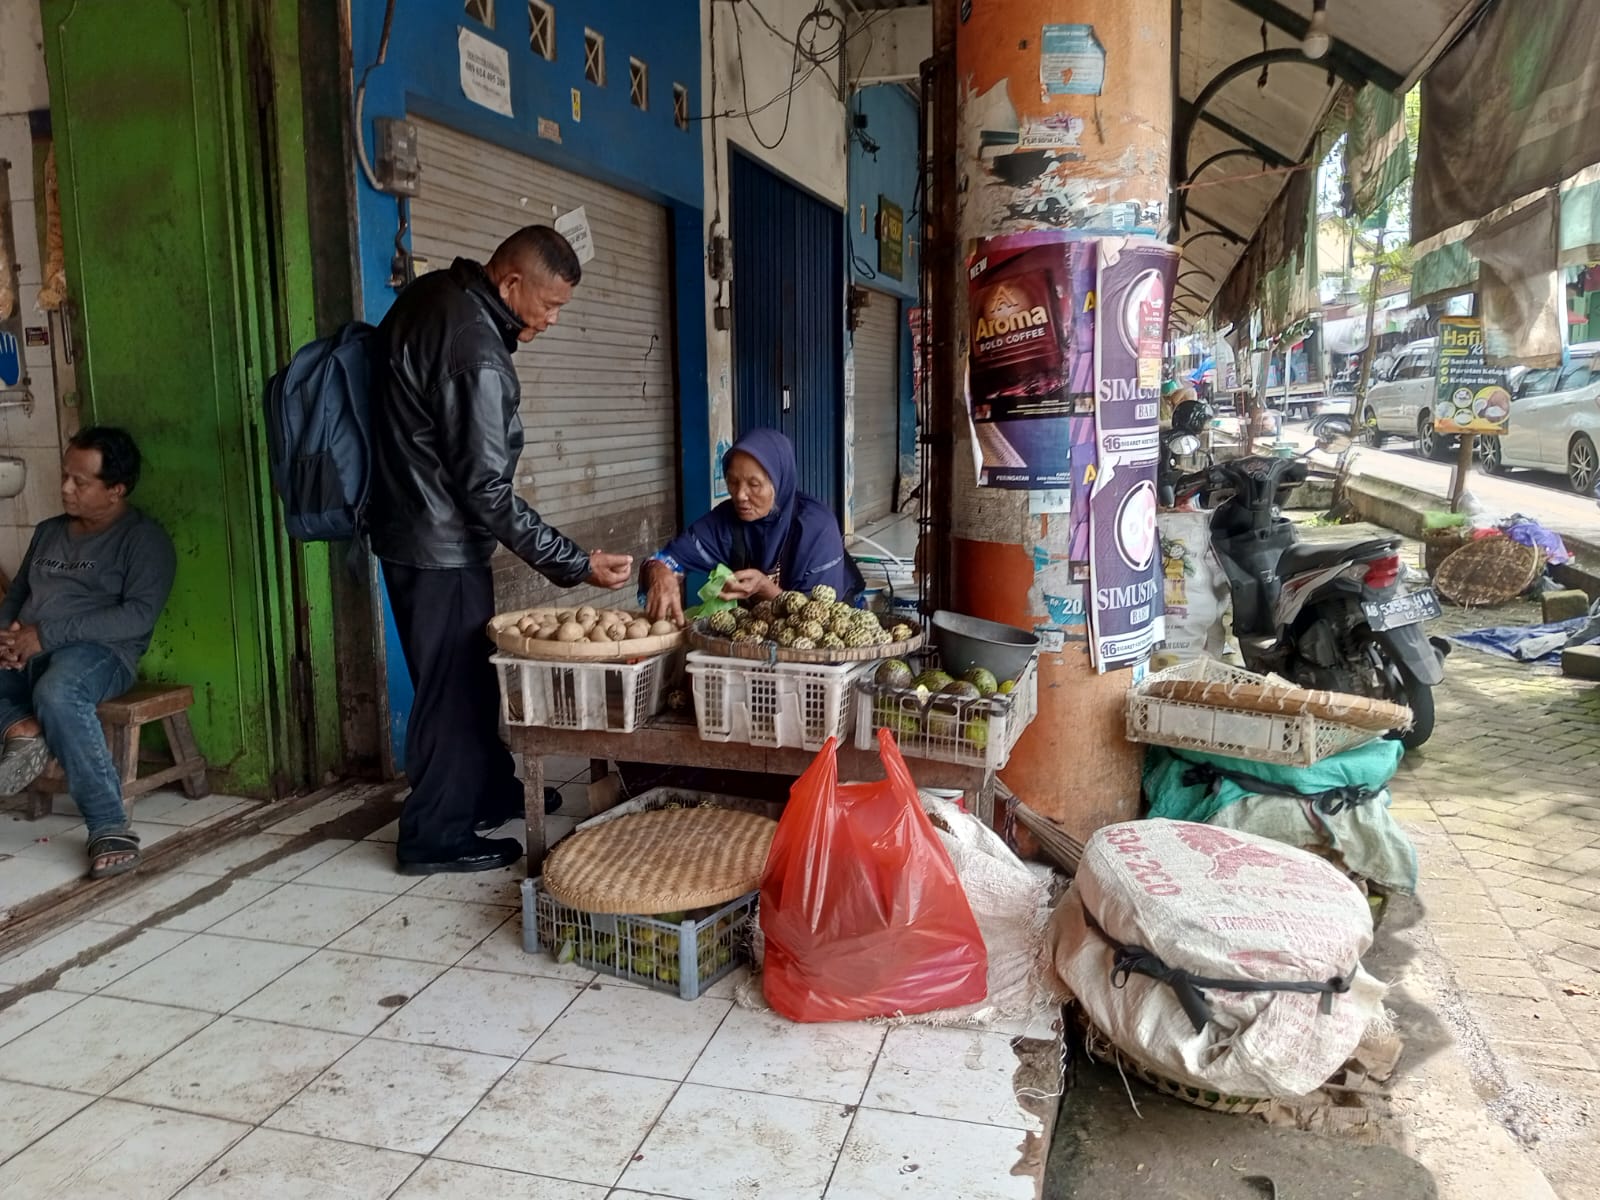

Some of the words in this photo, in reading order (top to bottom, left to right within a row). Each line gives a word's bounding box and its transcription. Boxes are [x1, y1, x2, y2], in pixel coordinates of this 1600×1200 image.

[970, 257, 988, 280] NEW
[976, 306, 1048, 341] Aroma
[980, 339, 1003, 352] BOLD
[1006, 327, 1046, 344] COFFEE
[1105, 438, 1121, 450] 16
[1103, 644, 1117, 656] 16
